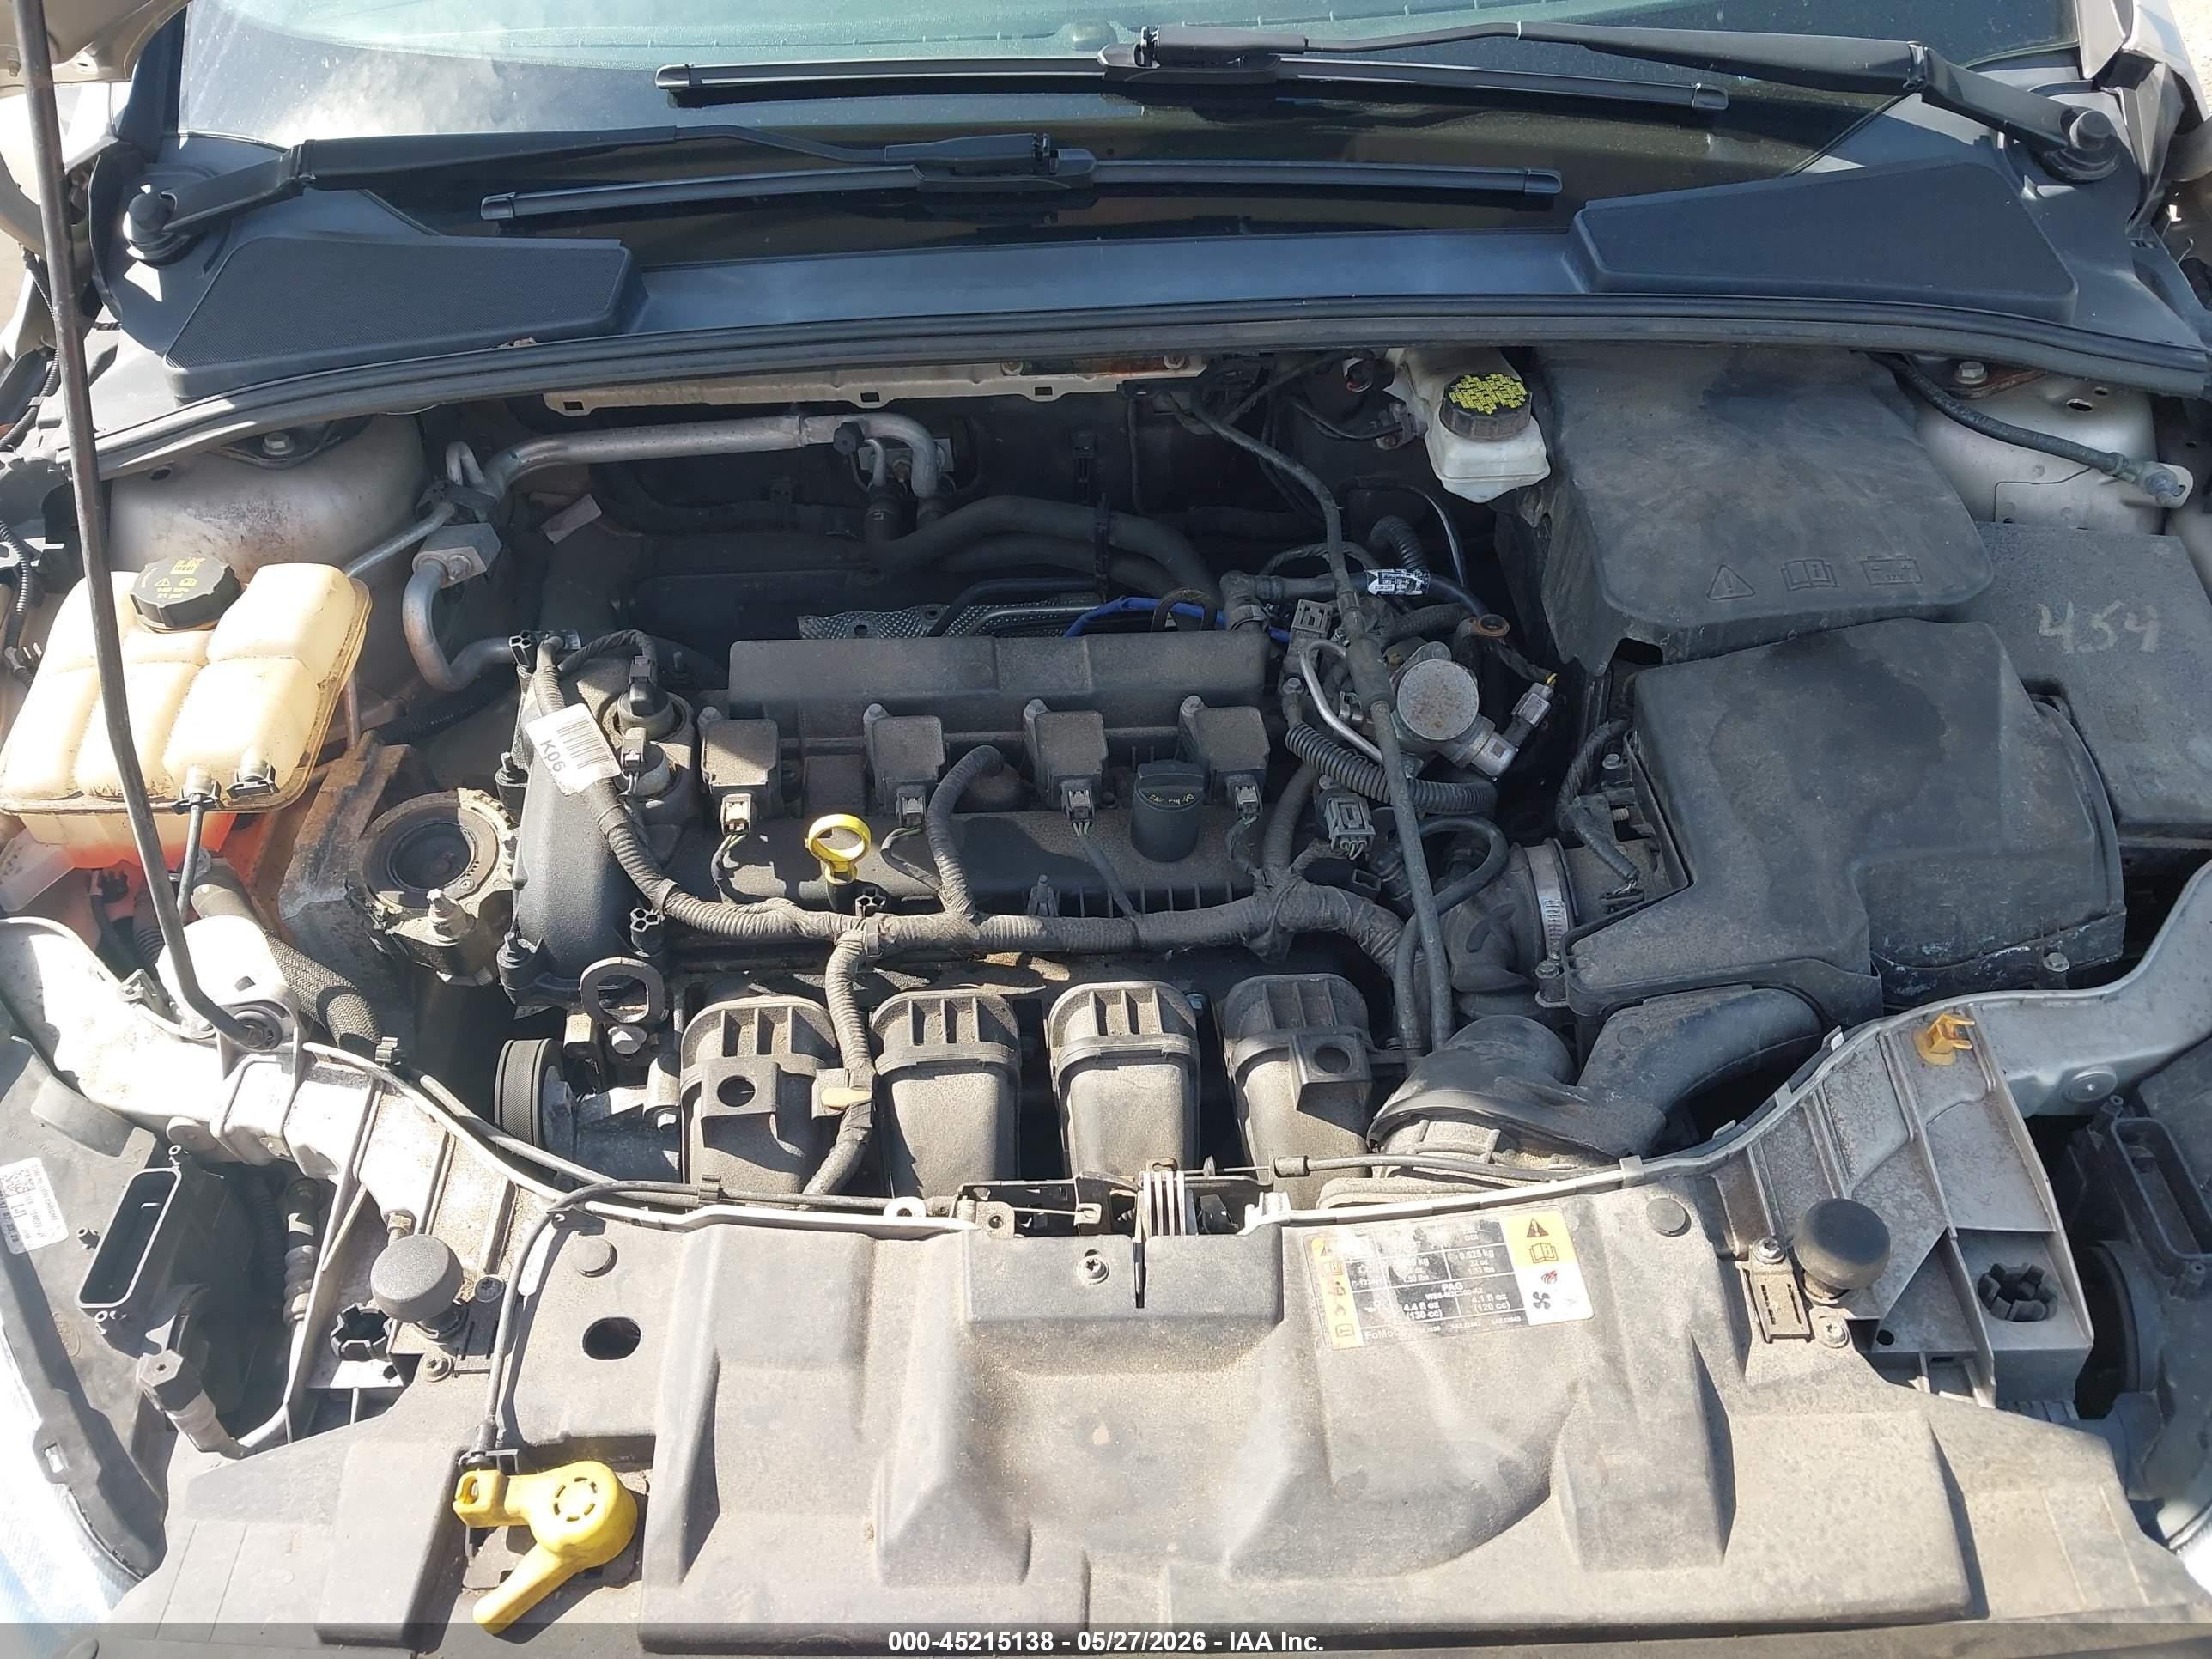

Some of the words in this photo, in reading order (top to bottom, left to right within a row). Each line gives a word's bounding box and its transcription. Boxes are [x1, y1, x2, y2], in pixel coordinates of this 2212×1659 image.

[540, 739, 567, 773] K06
[1482, 1249, 1495, 1259] kg
[1442, 1282, 1463, 1291] PAG
[1472, 1294, 1486, 1303] 4.1
[1495, 1292, 1507, 1301] oz
[1404, 1303, 1419, 1311] 4.4
[1428, 1301, 1440, 1310] oz
[1474, 1303, 1494, 1313] (120
[1496, 1301, 1511, 1310] cc)
[1407, 1311, 1425, 1322] (130
[1427, 1310, 1443, 1319] cc)
